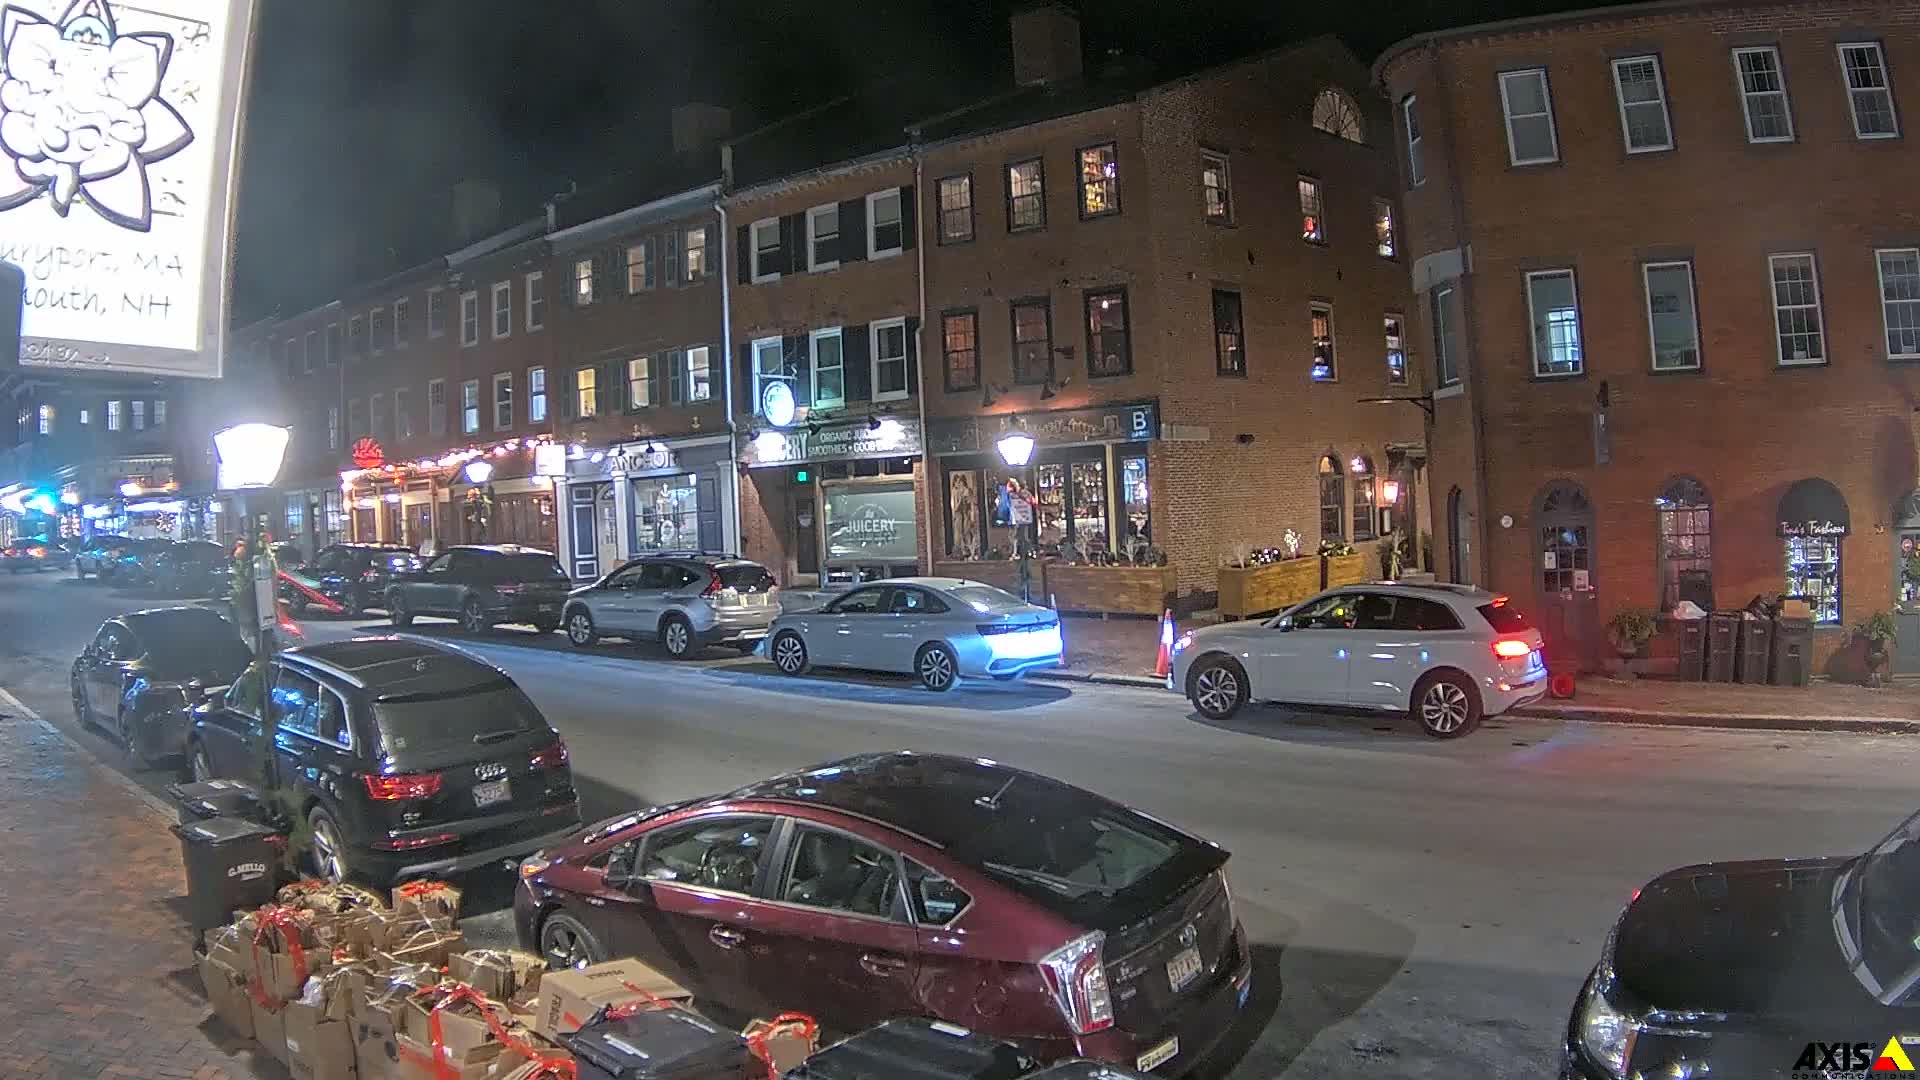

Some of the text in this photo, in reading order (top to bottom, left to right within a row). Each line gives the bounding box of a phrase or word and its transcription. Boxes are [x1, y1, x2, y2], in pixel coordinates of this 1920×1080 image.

[132, 250, 184, 279] MA
[121, 290, 172, 320] NH
[820, 430, 852, 443] ORGANIC
[846, 518, 895, 532] JUICERY
[1808, 520, 1845, 535] Fashion
